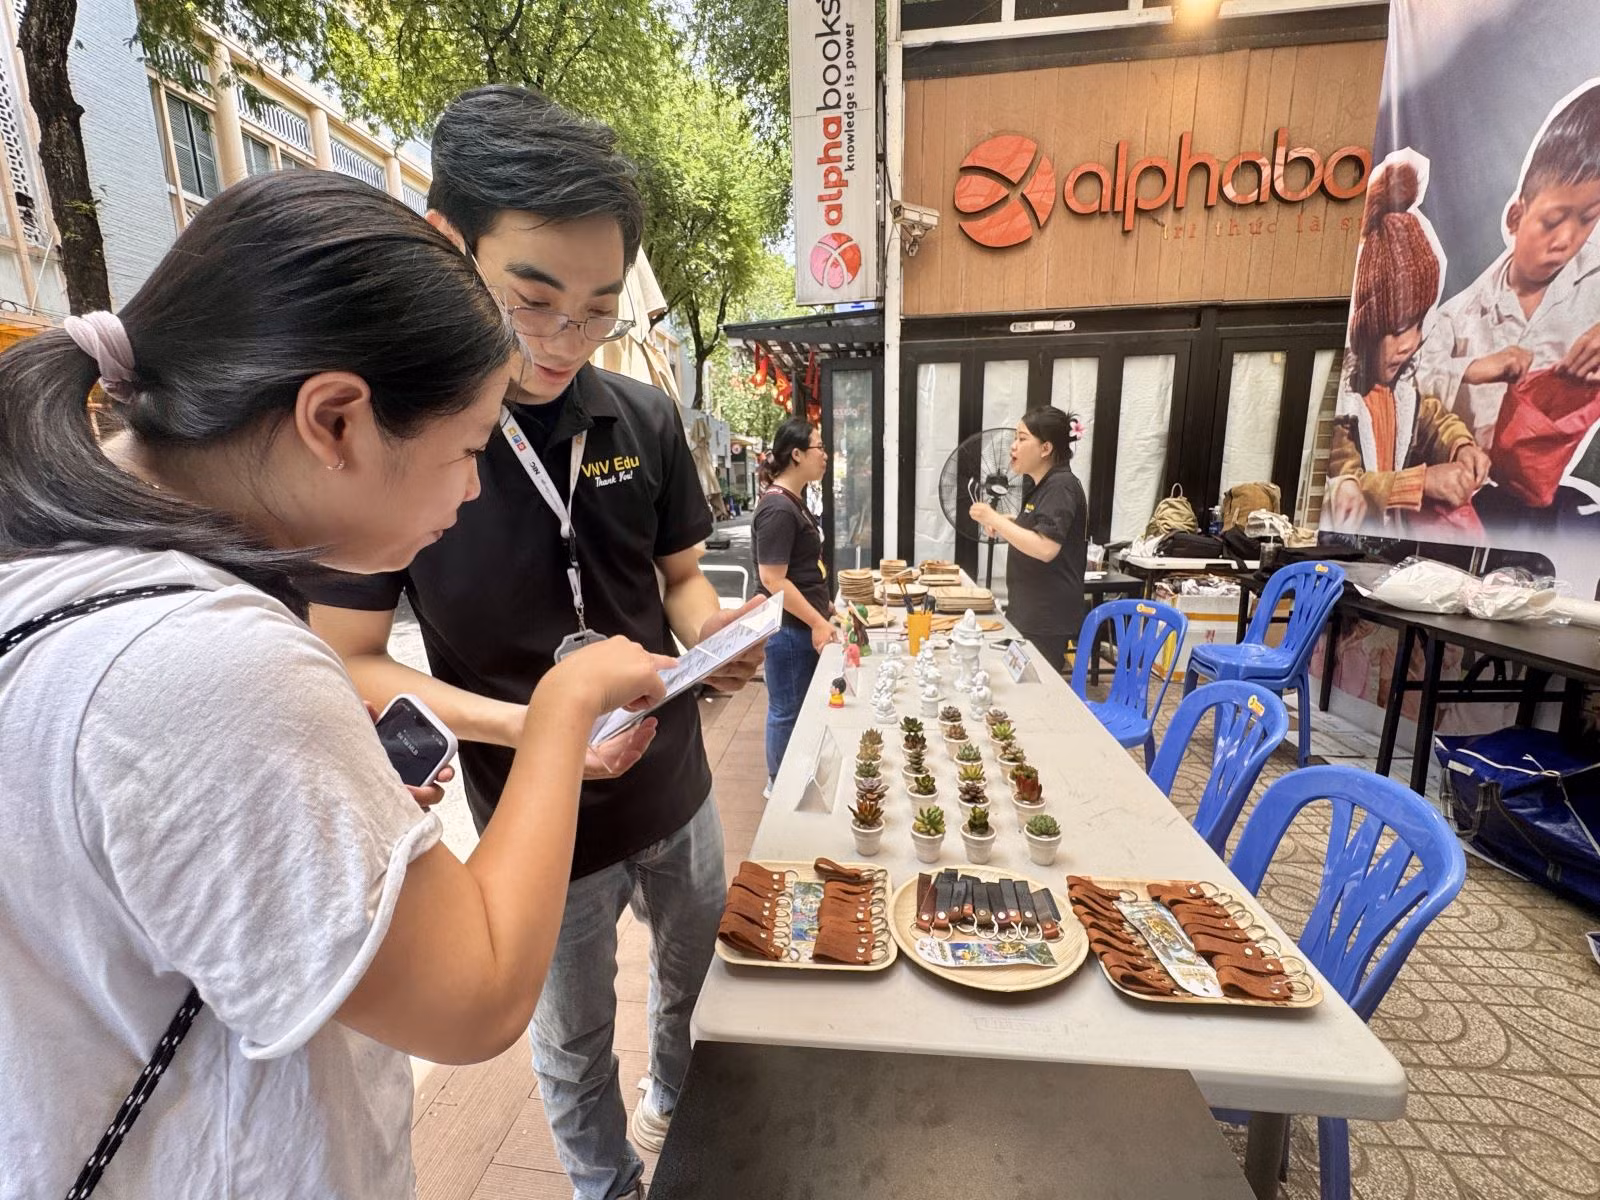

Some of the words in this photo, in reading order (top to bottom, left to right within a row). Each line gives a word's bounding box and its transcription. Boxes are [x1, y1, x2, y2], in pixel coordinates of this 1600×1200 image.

[845, 22, 857, 74] power
[844, 75, 855, 87] is
[844, 92, 857, 172] knowledge
[1295, 213, 1321, 234] là
[530, 461, 541, 475] NIC
[581, 460, 609, 477] VNV
[614, 456, 639, 471] Edu
[595, 475, 616, 487] Thank
[619, 470, 632, 482] You!
